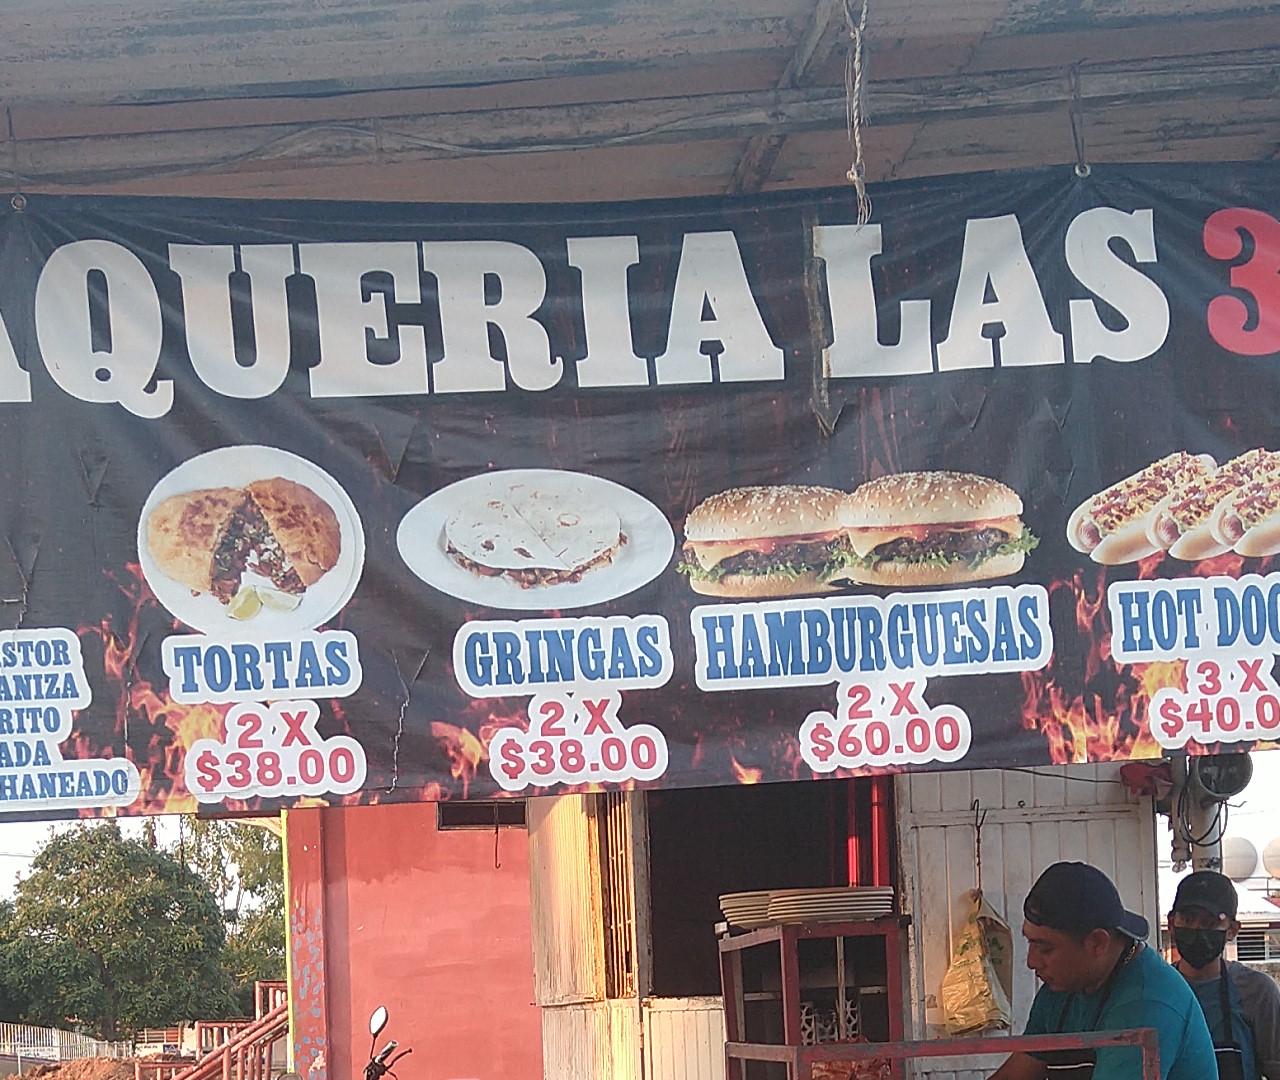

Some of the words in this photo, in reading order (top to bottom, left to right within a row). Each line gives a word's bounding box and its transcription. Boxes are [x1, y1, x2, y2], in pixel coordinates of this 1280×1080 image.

[819, 206, 1170, 378] LAS
[701, 596, 1044, 680] HAMBURGUESAS
[1119, 588, 1202, 653] HOT
[173, 640, 351, 694] TORTAS
[464, 626, 664, 687] GRINGAS
[195, 747, 357, 791] $38.00
[500, 734, 658, 779] $38.00
[809, 720, 962, 763] $60.00
